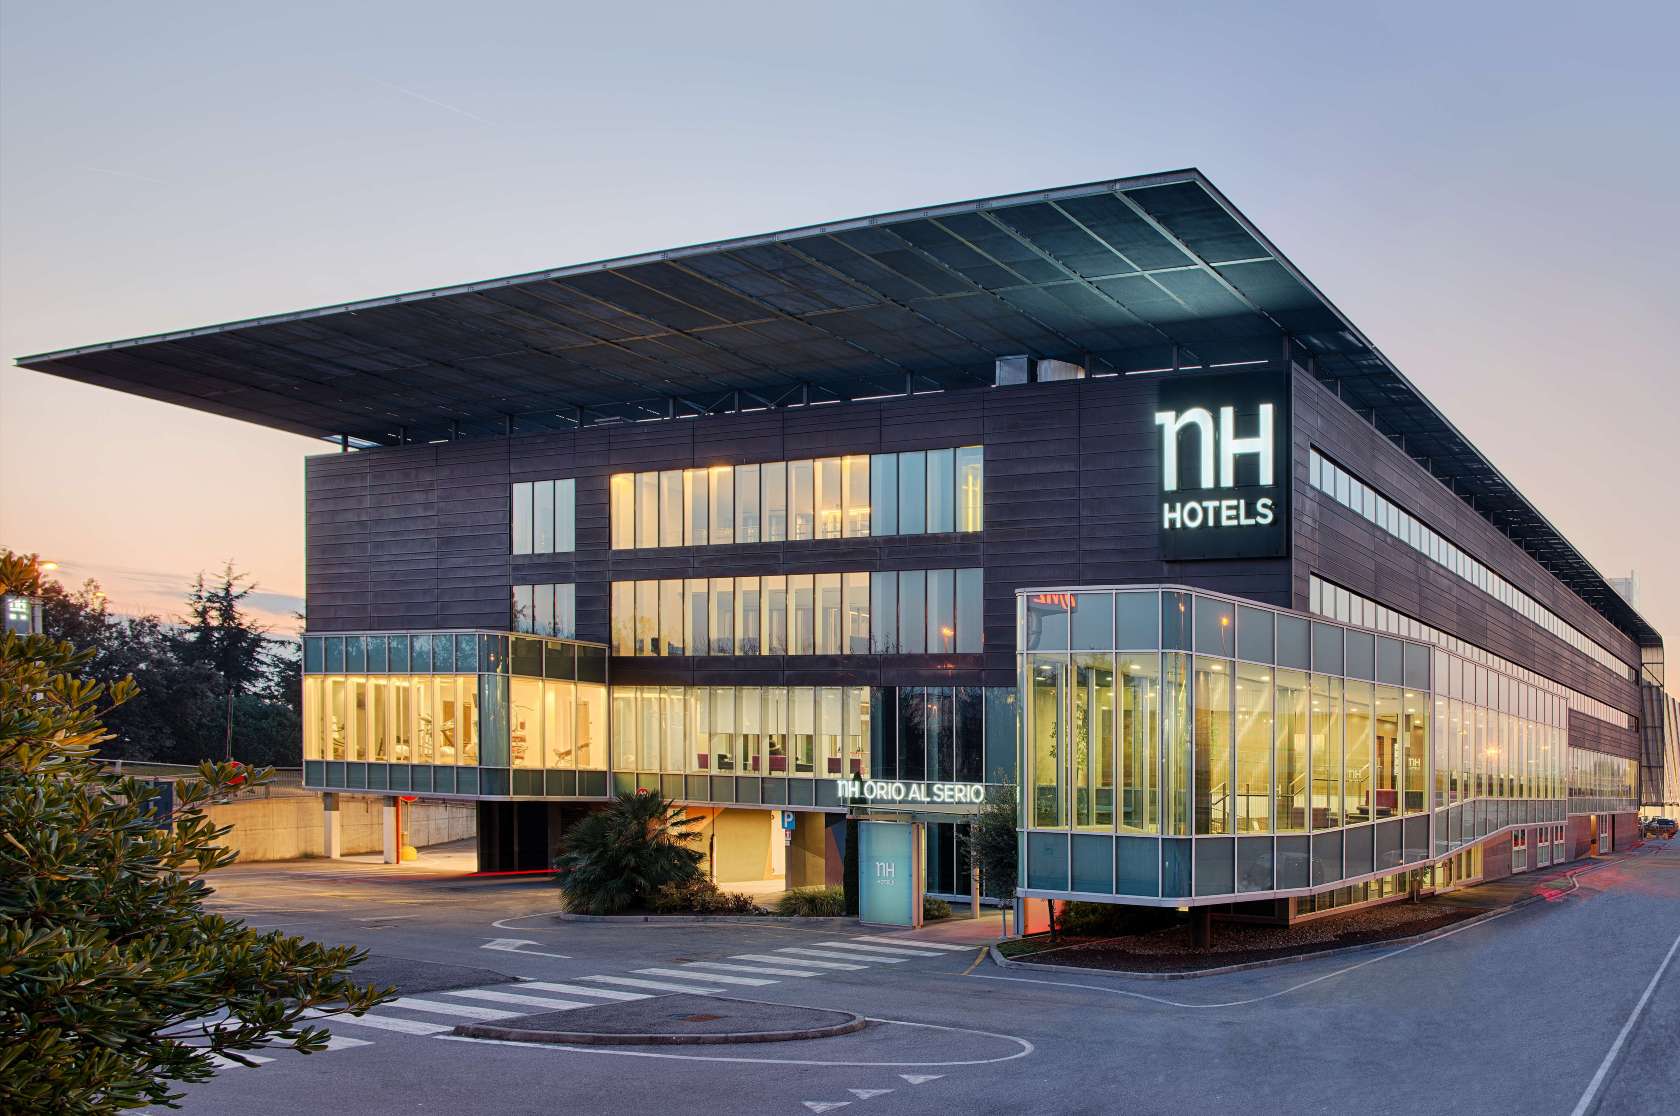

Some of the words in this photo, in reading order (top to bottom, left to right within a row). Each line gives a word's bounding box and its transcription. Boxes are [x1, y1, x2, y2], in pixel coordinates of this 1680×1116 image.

[1155, 403, 1274, 491] nH
[1163, 498, 1274, 529] HOTELS
[837, 780, 860, 798] nH
[863, 781, 904, 800] ORIO
[908, 783, 930, 801] AL
[933, 784, 985, 803] SERIO
[784, 812, 794, 828] P
